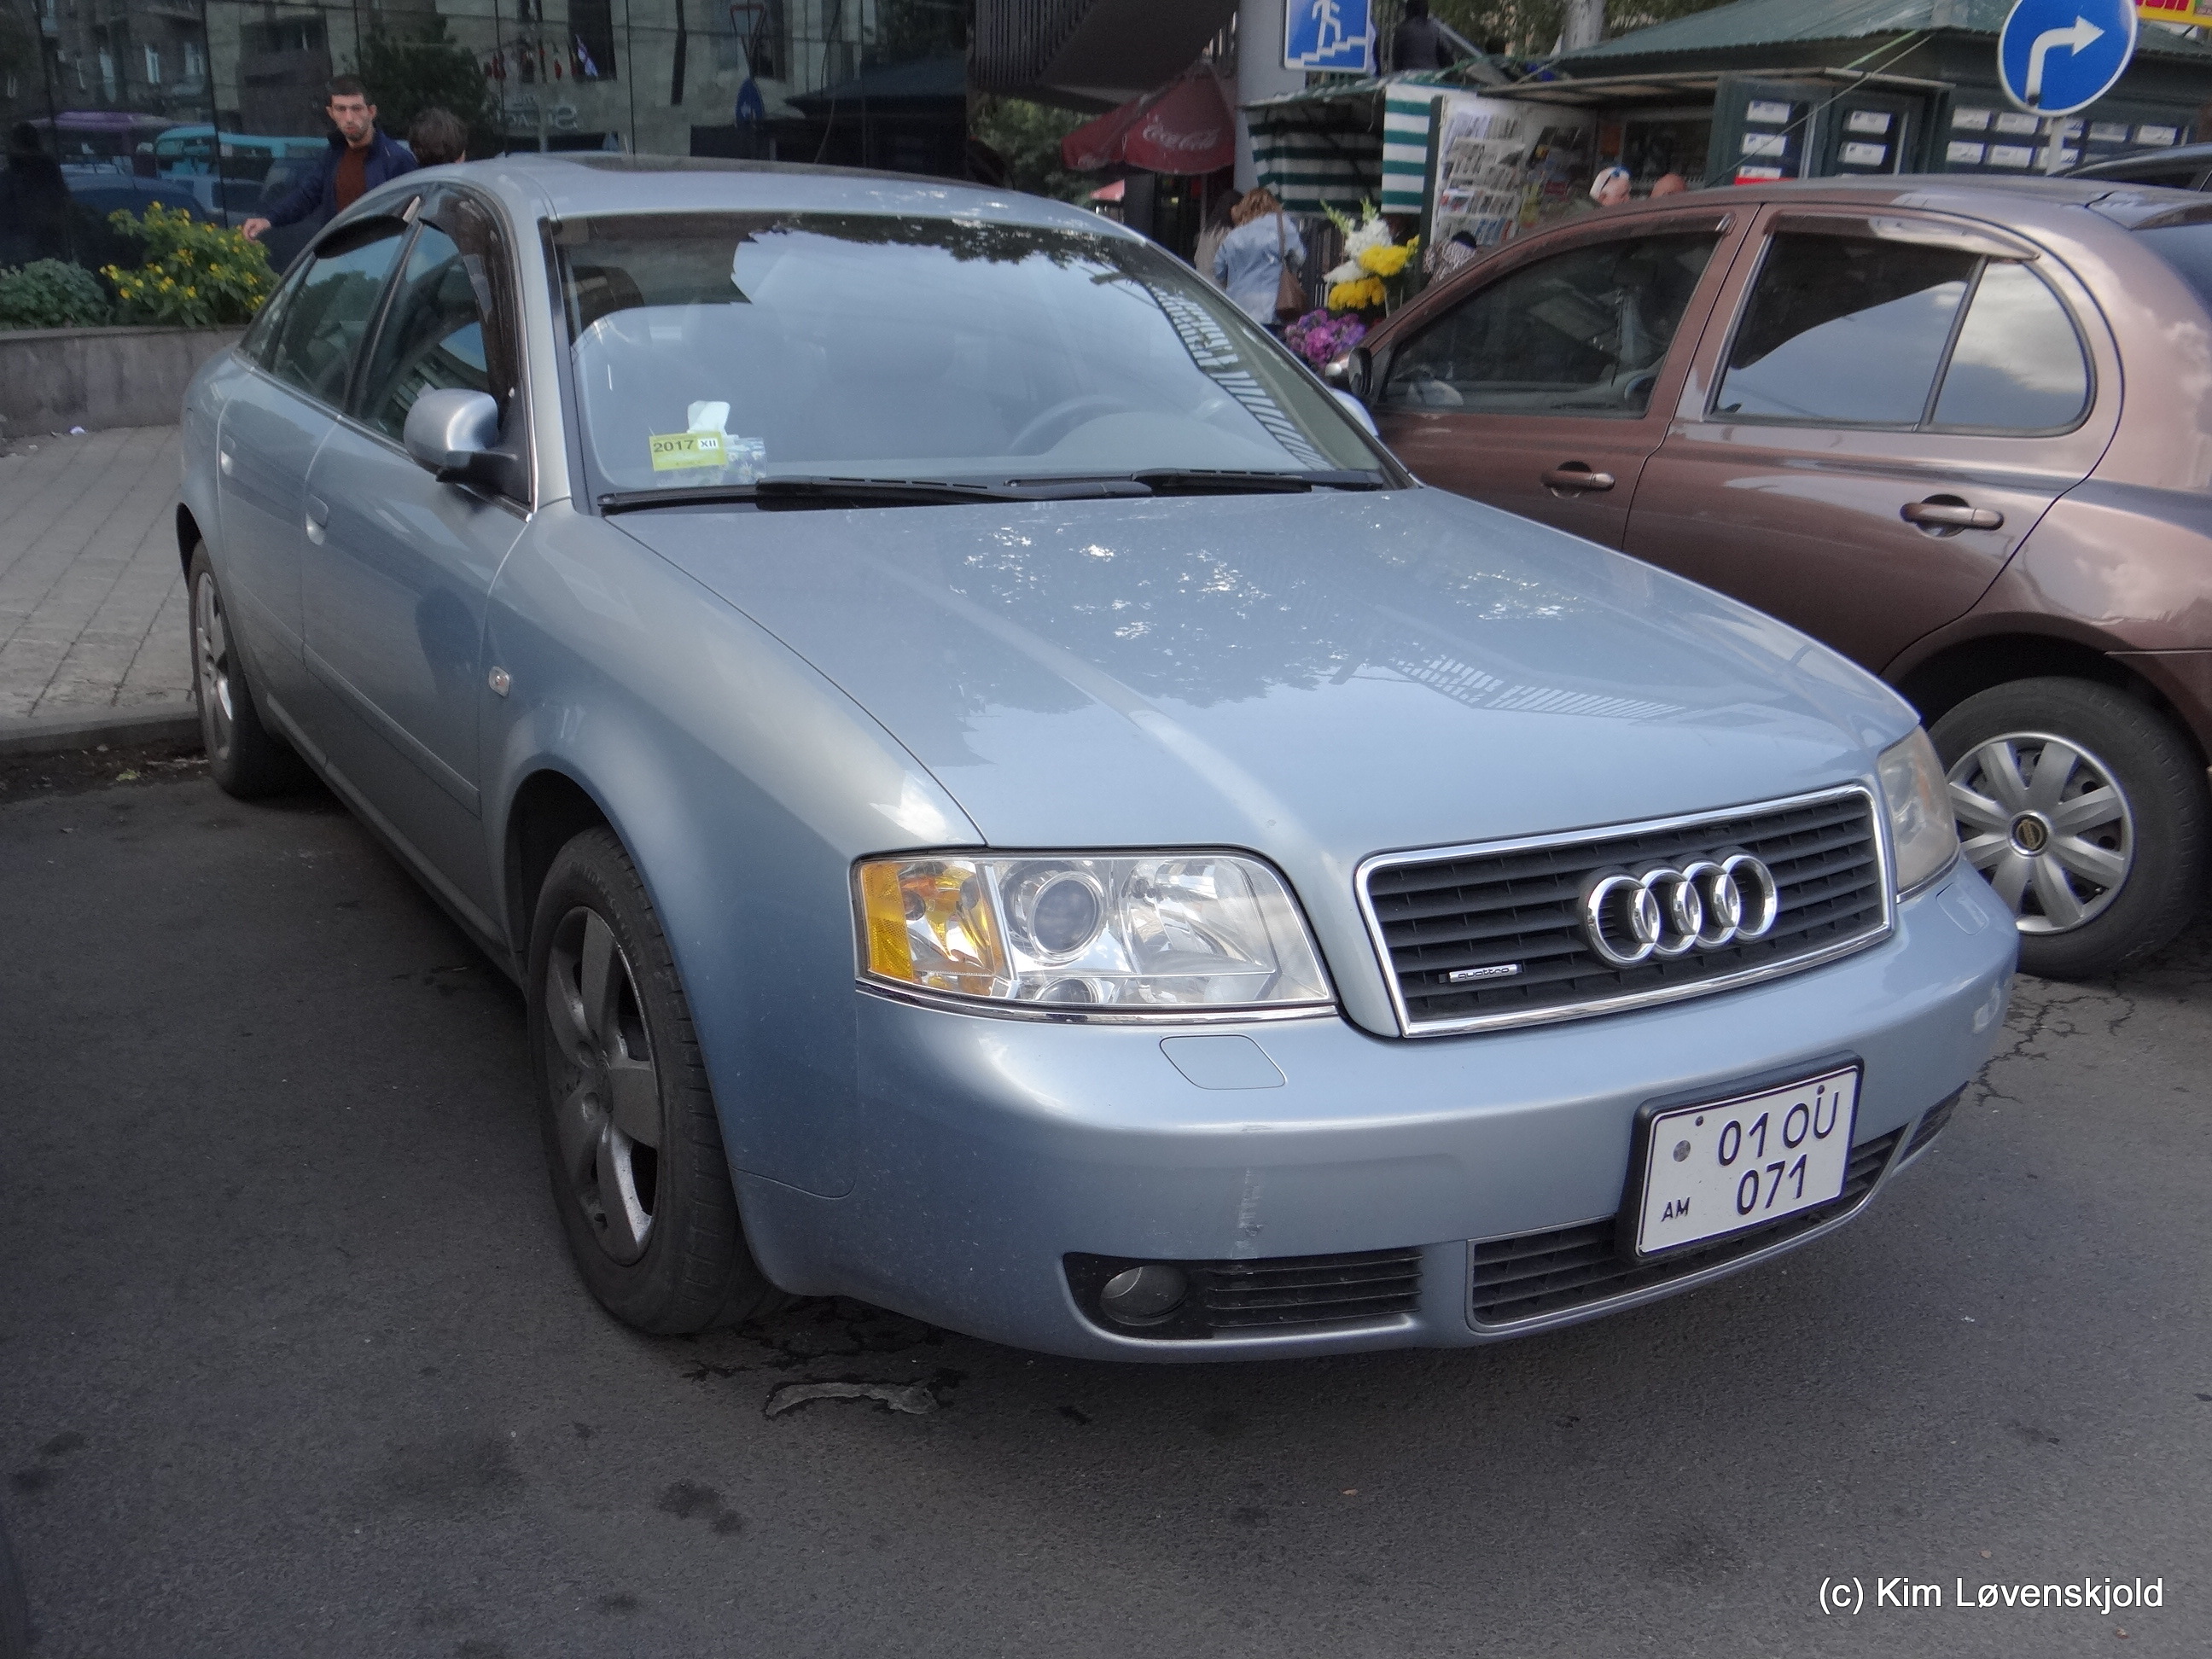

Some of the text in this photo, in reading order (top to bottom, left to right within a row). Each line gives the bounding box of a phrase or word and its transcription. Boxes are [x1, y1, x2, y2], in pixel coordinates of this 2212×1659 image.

[653, 439, 717, 453] 2017 XII
[1458, 966, 1510, 980] quattro
[1718, 1111, 1769, 1166] 01
[1736, 1153, 1807, 1216] 071
[1661, 1196, 1691, 1222] AM
